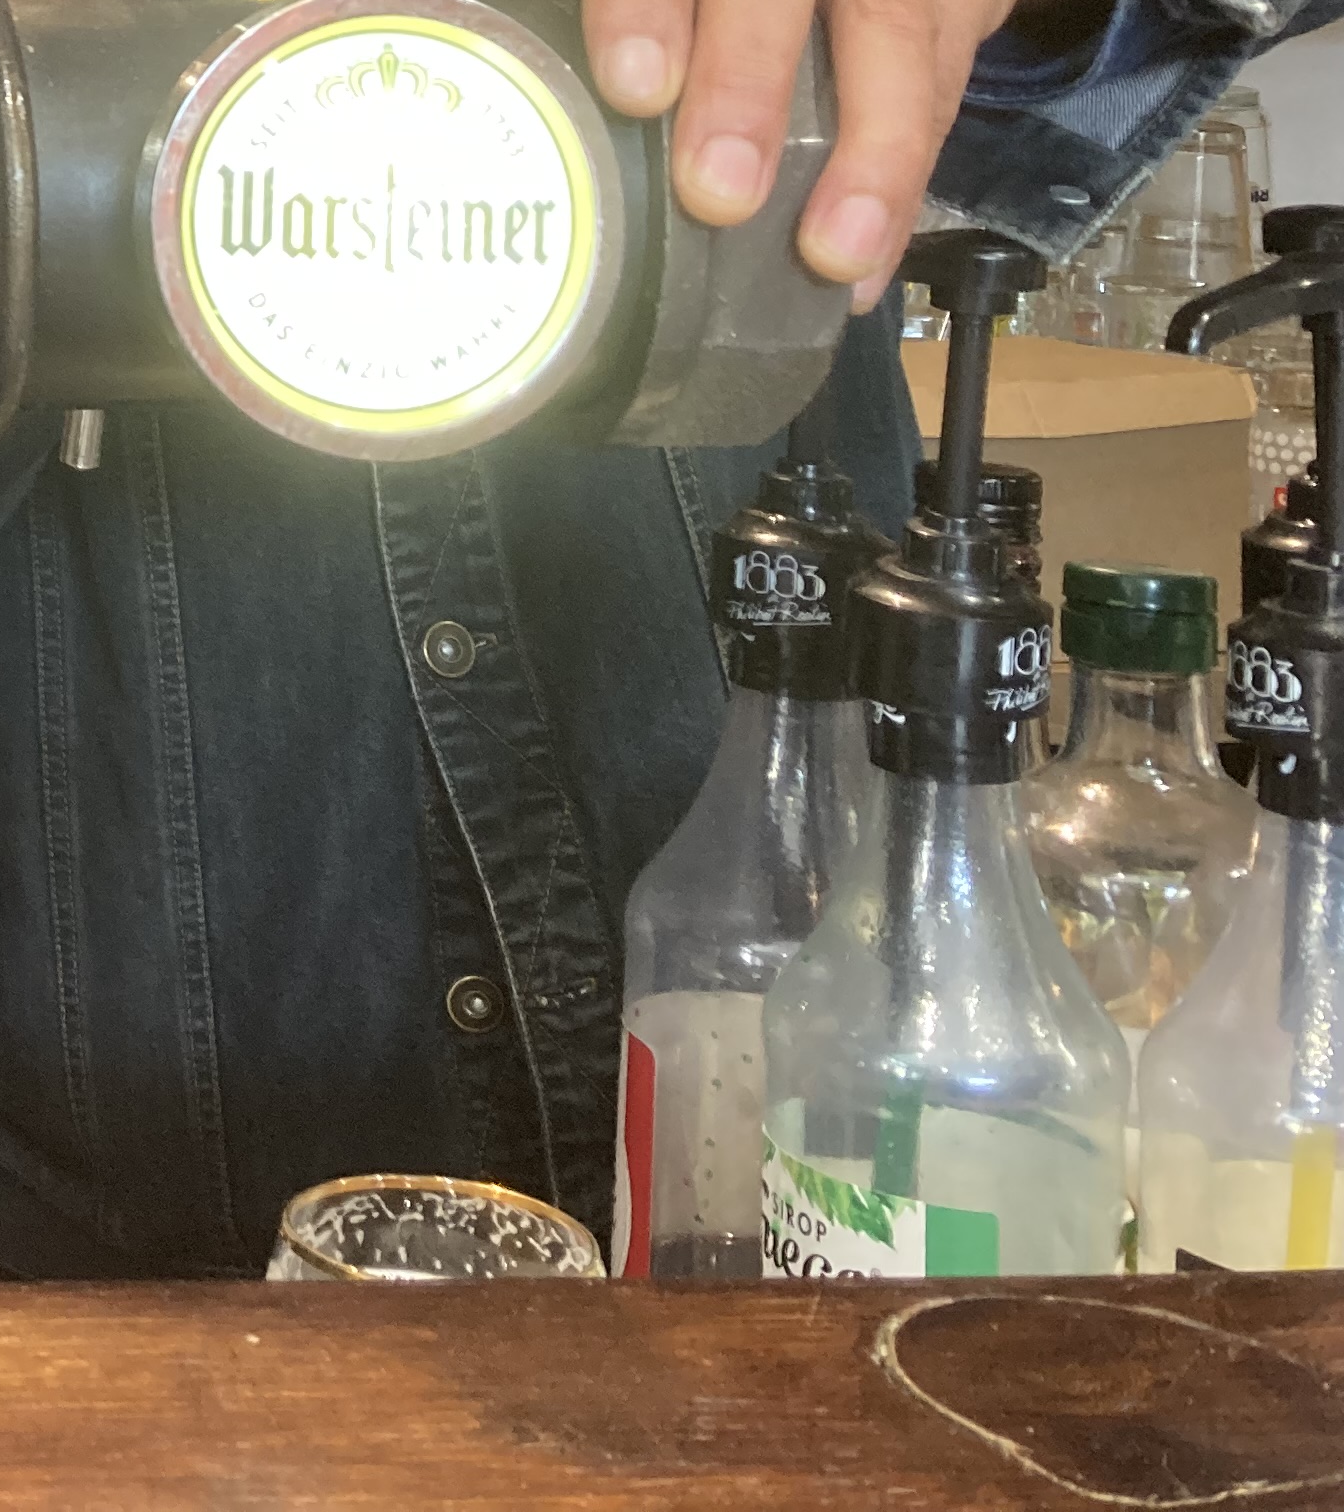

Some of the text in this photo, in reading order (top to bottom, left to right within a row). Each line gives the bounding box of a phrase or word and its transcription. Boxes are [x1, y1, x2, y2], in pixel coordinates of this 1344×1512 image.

[217, 163, 557, 273] Warsteiner
[733, 550, 826, 601] 1883
[772, 1192, 827, 1243] SIROP
